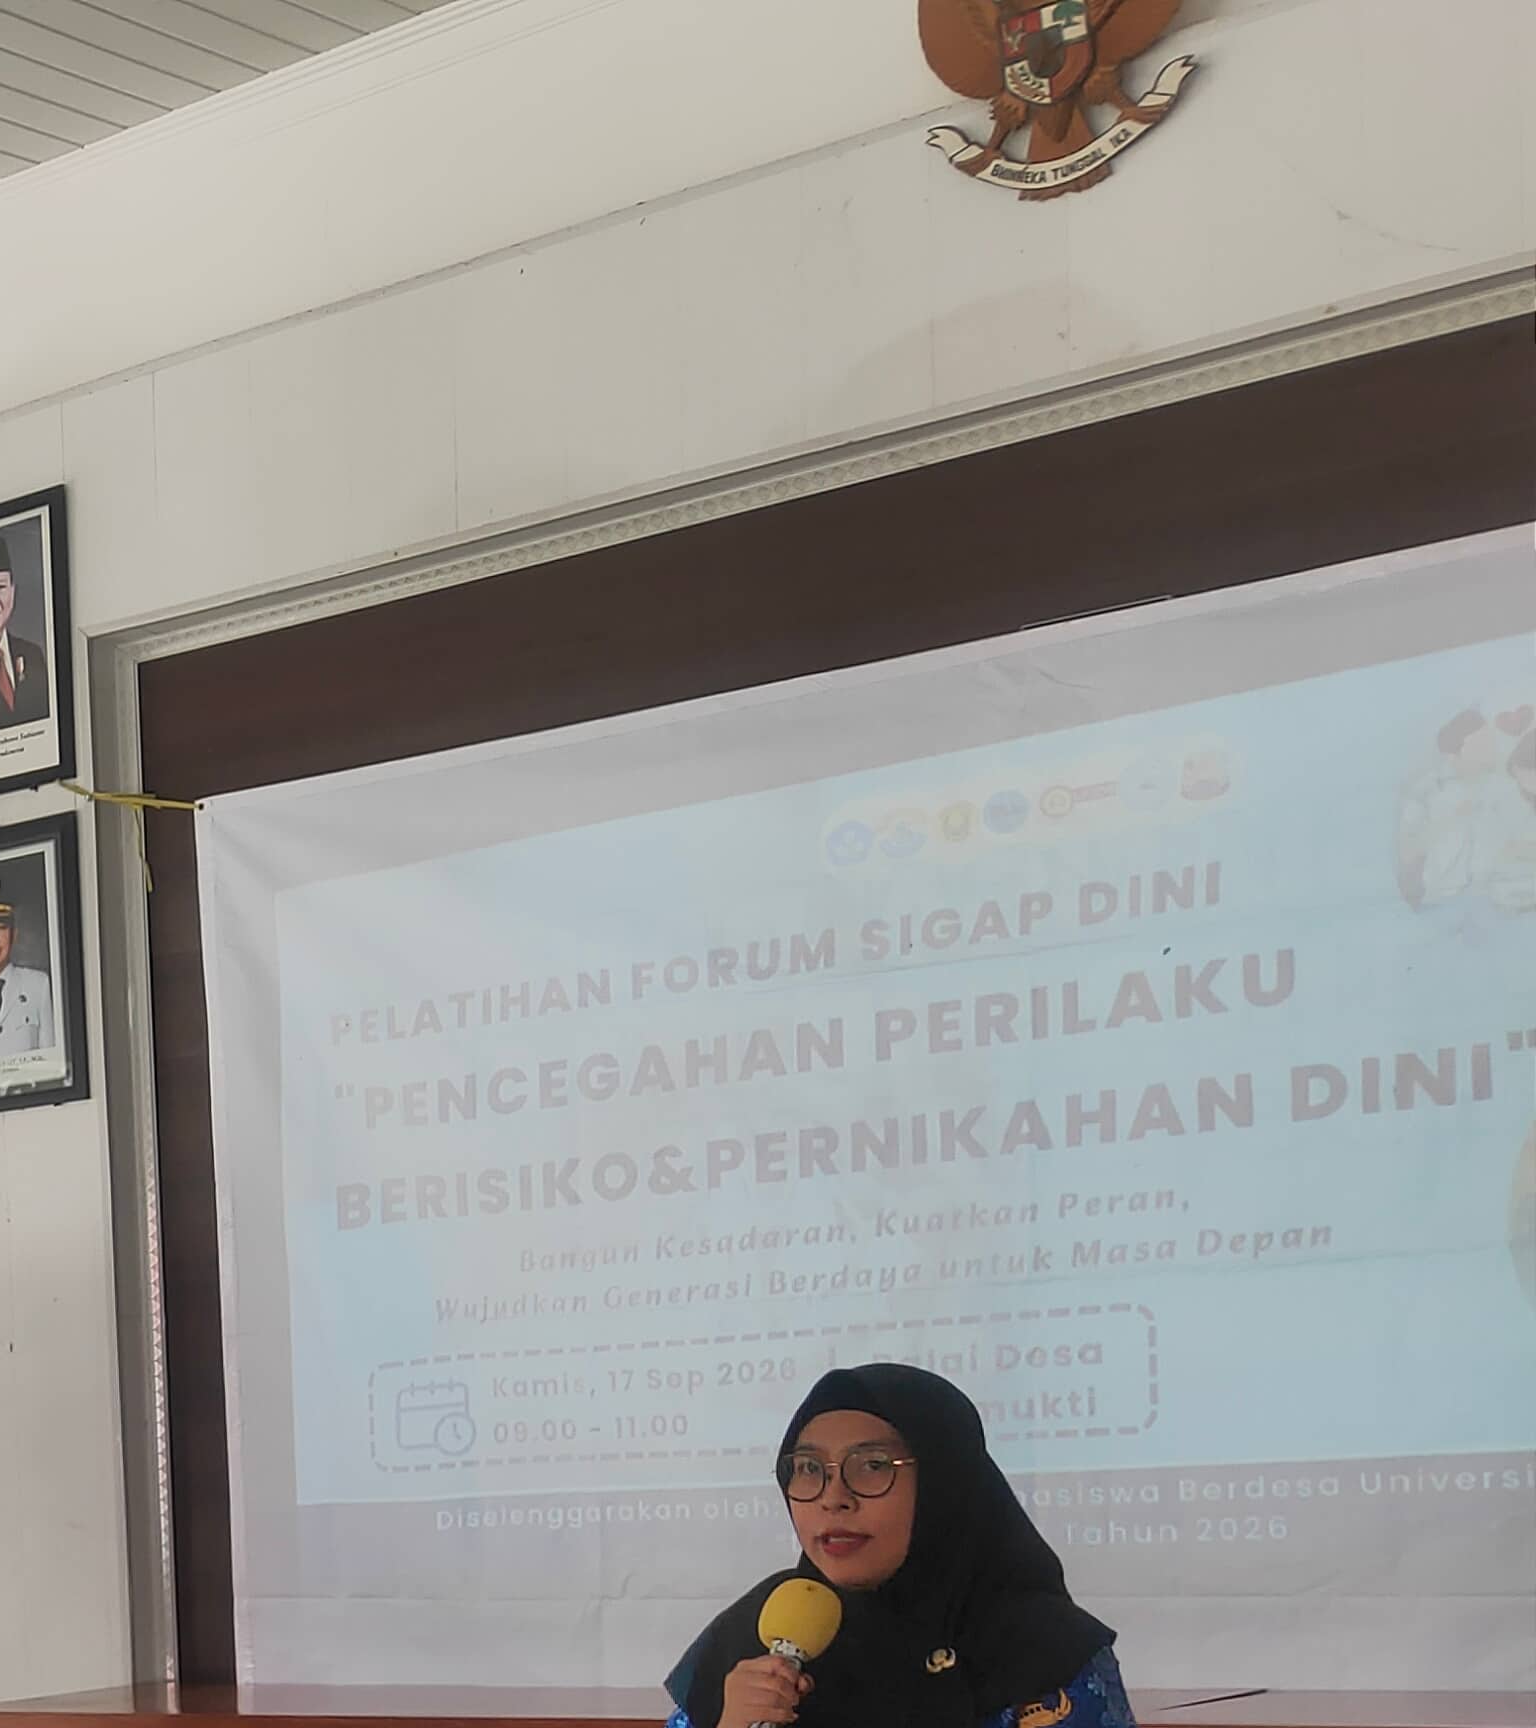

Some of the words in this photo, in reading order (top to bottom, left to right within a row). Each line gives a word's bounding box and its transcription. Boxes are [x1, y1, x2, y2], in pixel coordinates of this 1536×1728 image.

[329, 967, 613, 1047] PELATIHAN
[631, 927, 837, 1000] FORUM
[860, 889, 1055, 961] SIGAP
[1077, 859, 1224, 928] DINI
[874, 946, 1296, 1062] PERILAKU
[519, 1240, 640, 1274] Bangun
[655, 1219, 858, 1262] Kesadaran,
[873, 1201, 1040, 1240] Kuatkan
[1058, 1185, 1191, 1220] Peran,
[435, 1295, 588, 1327] Wujudkan
[603, 1272, 753, 1313] Generasi
[767, 1257, 922, 1297] Berdaya
[939, 1242, 1053, 1281] untuk
[1070, 1235, 1178, 1269] Masa
[1196, 1220, 1333, 1260] Depan
[492, 1375, 599, 1399] Kamis,
[607, 1368, 634, 1393] 17
[995, 1341, 1104, 1371] Desa
[614, 1411, 688, 1439] 11.00
[436, 1498, 693, 1531] Diselenggarakan
[1179, 1472, 1341, 1505] Berdesa
[1360, 1461, 1536, 1496] Universi
[1065, 1517, 1180, 1546] Tahun
[1196, 1516, 1289, 1545] 2026
